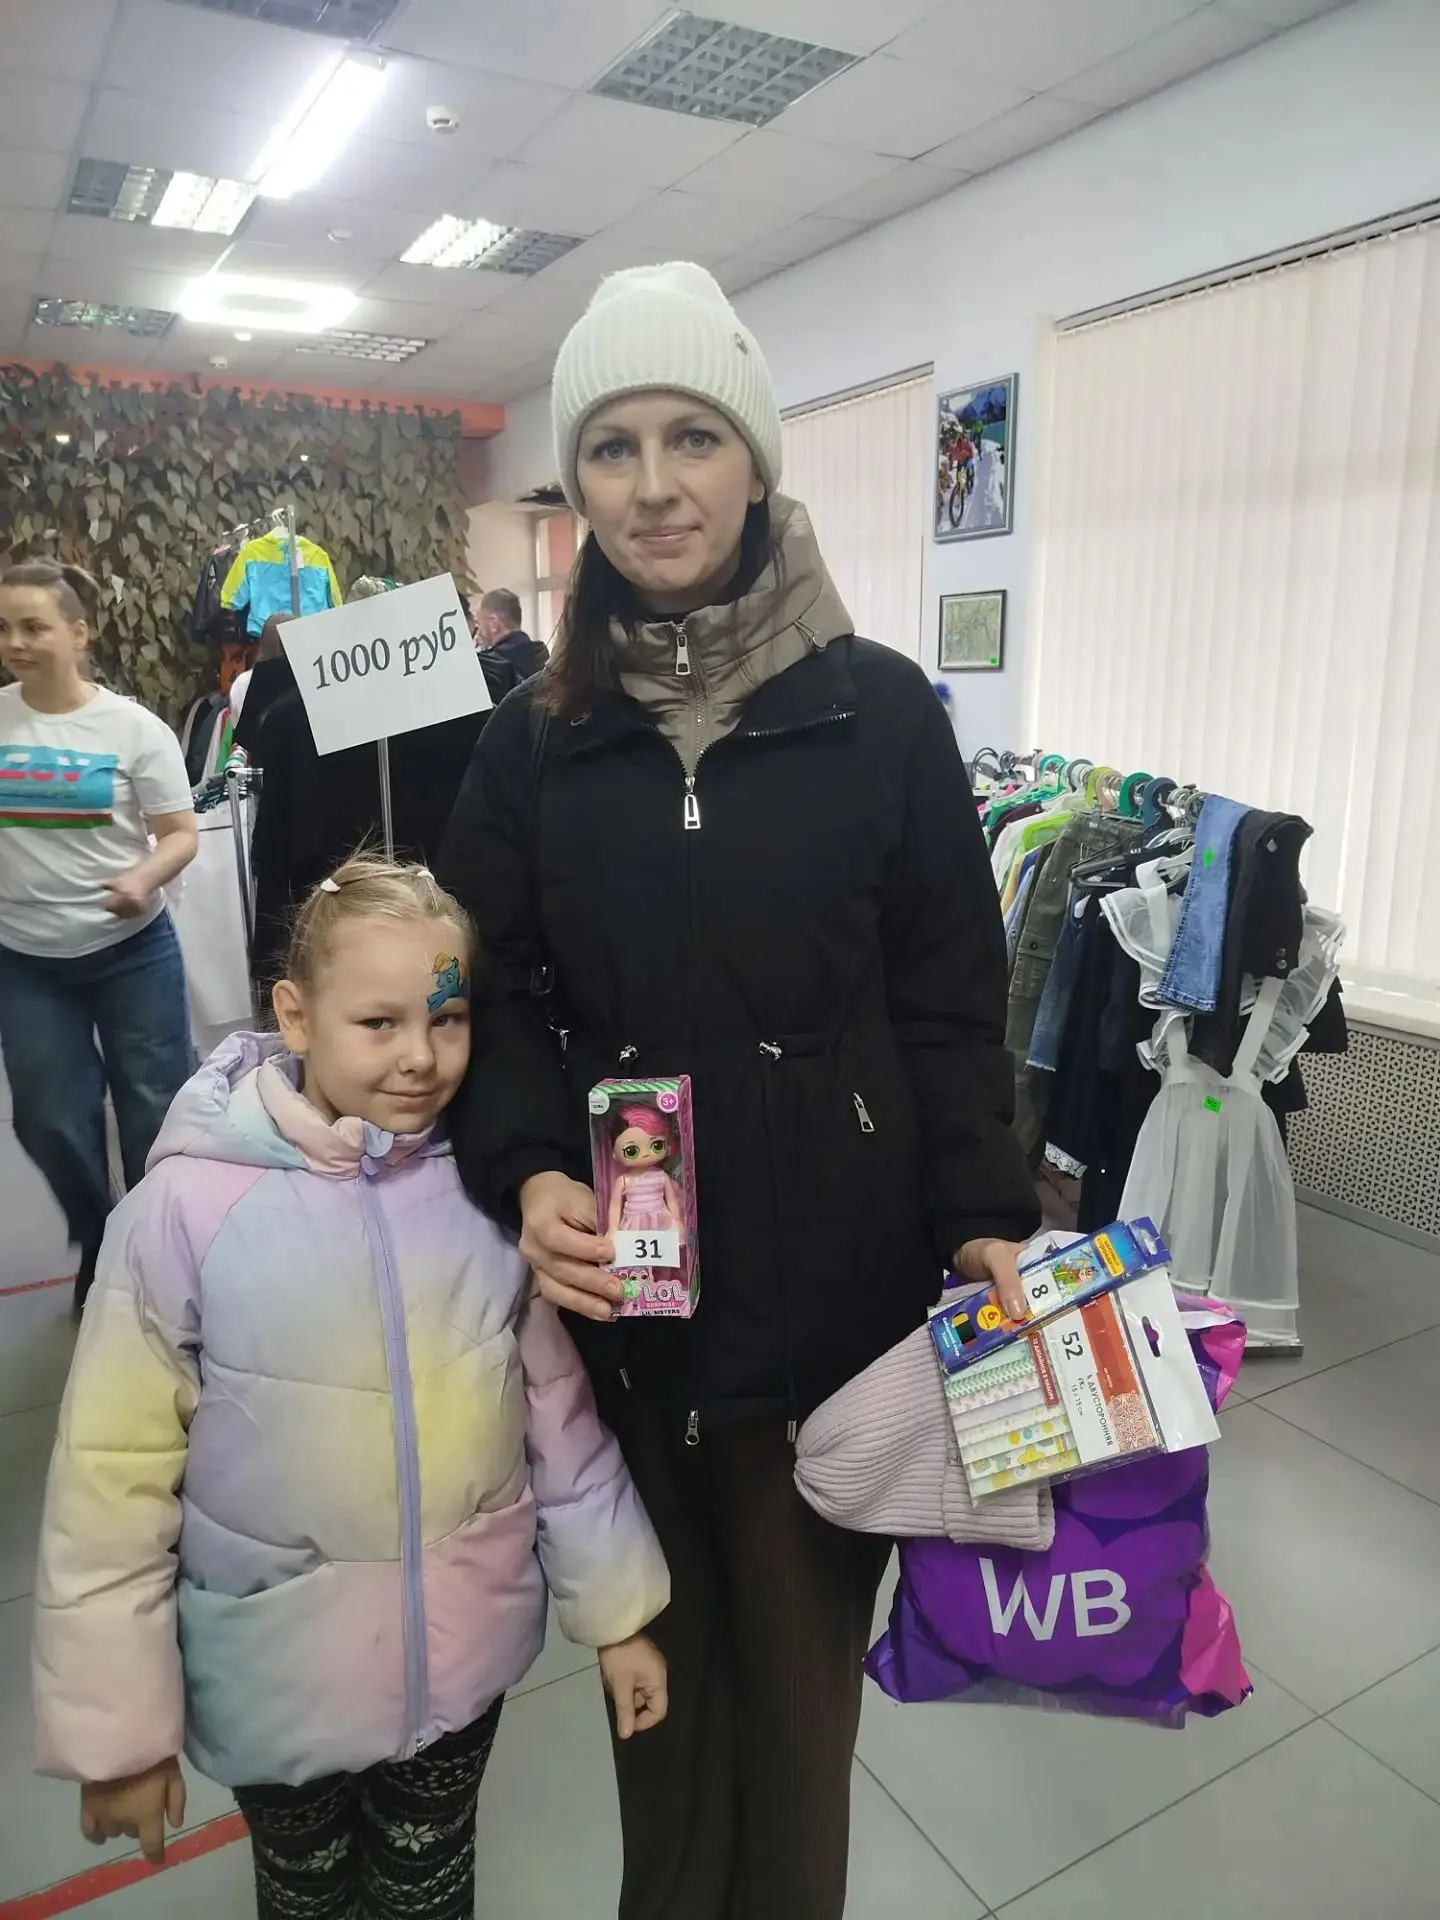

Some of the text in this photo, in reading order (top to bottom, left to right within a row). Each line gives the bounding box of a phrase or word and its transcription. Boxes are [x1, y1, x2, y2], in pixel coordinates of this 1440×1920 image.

[312, 609, 458, 690] 1000 руб
[662, 1097, 675, 1106] 3+
[634, 1238, 663, 1260] 31
[1031, 1283, 1049, 1299] 8
[987, 1311, 998, 1321] 6
[1061, 1331, 1084, 1361] 52
[1087, 1380, 1113, 1446] ДВУСТОРОННЯЯ
[978, 1557, 1132, 1641] WB
